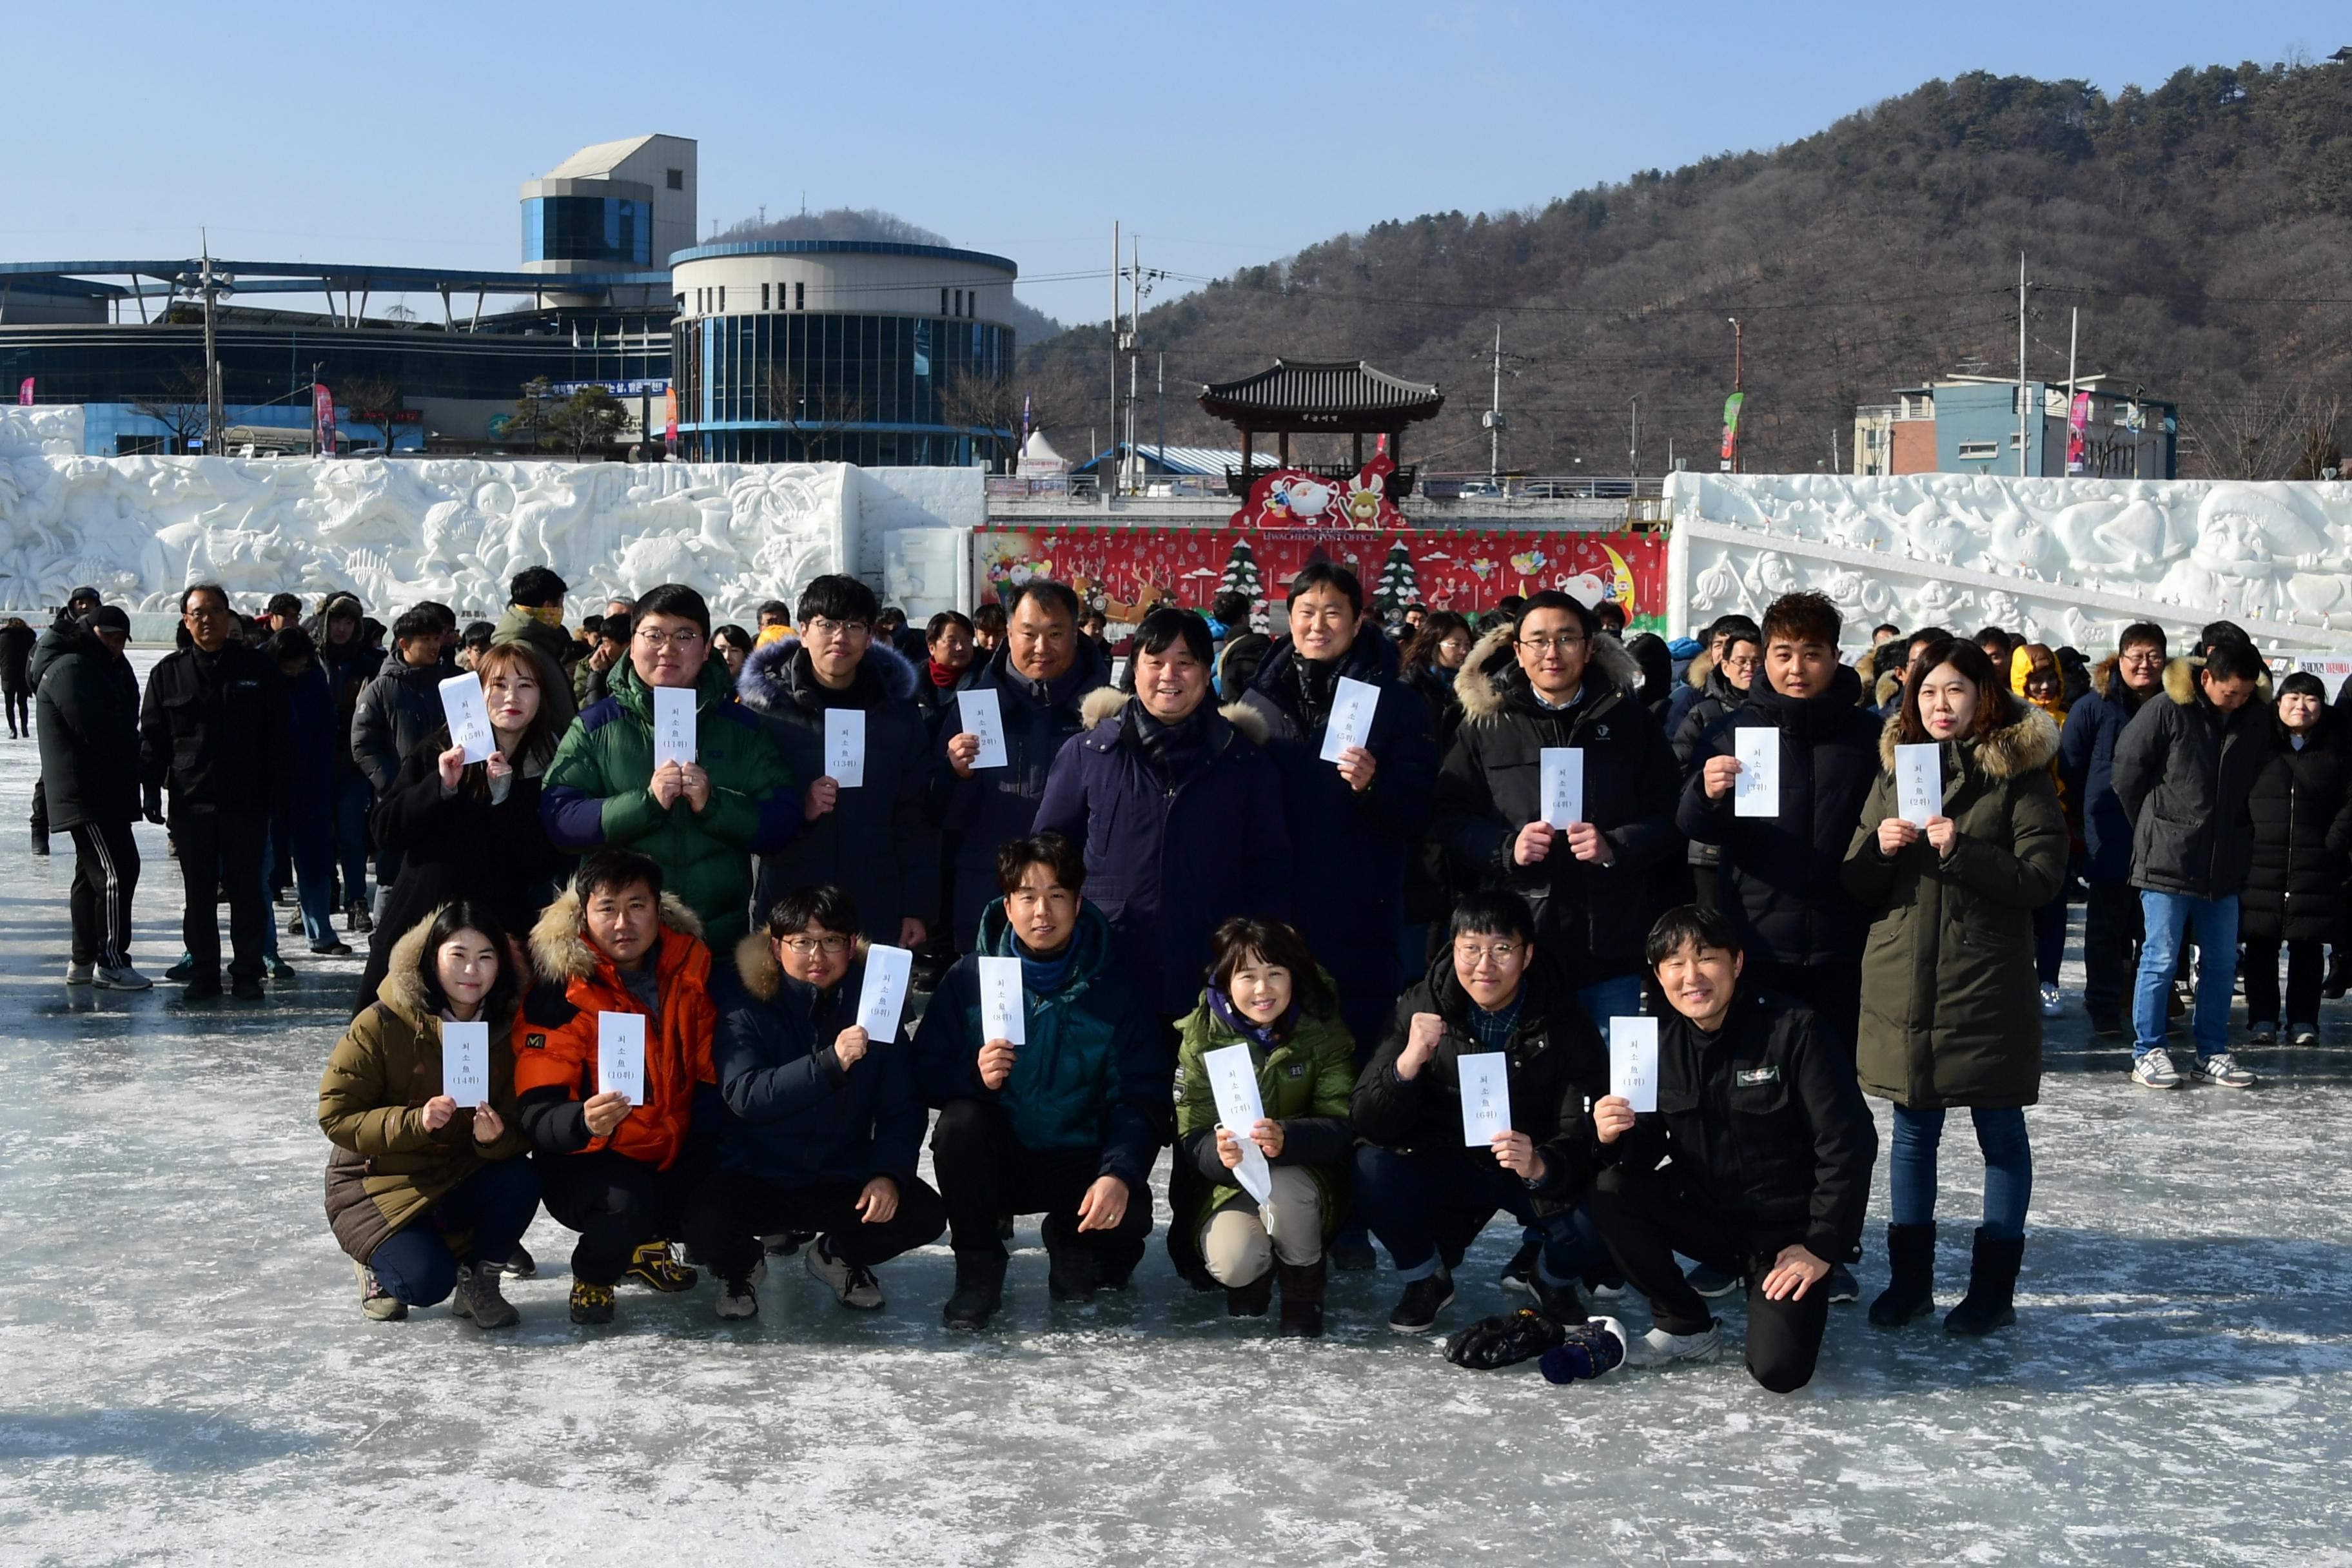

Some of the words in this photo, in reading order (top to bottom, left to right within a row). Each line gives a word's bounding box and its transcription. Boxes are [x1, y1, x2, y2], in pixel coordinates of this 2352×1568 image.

[1263, 532, 1317, 541] HWACHEON
[1318, 532, 1341, 542] POST
[460, 730, 484, 741] (15위)
[1337, 732, 1356, 743] (5위)
[663, 740, 687, 749] (11위)
[1747, 783, 1767, 791] (3위)
[1910, 798, 1930, 806] (2위)
[870, 1008, 890, 1017] (9위)
[993, 1013, 1012, 1021] (8위)
[453, 1076, 480, 1084] (14위)
[607, 1071, 634, 1080] (10위)
[1623, 1077, 1645, 1087] (1위)
[1230, 1103, 1250, 1114] (7위)
